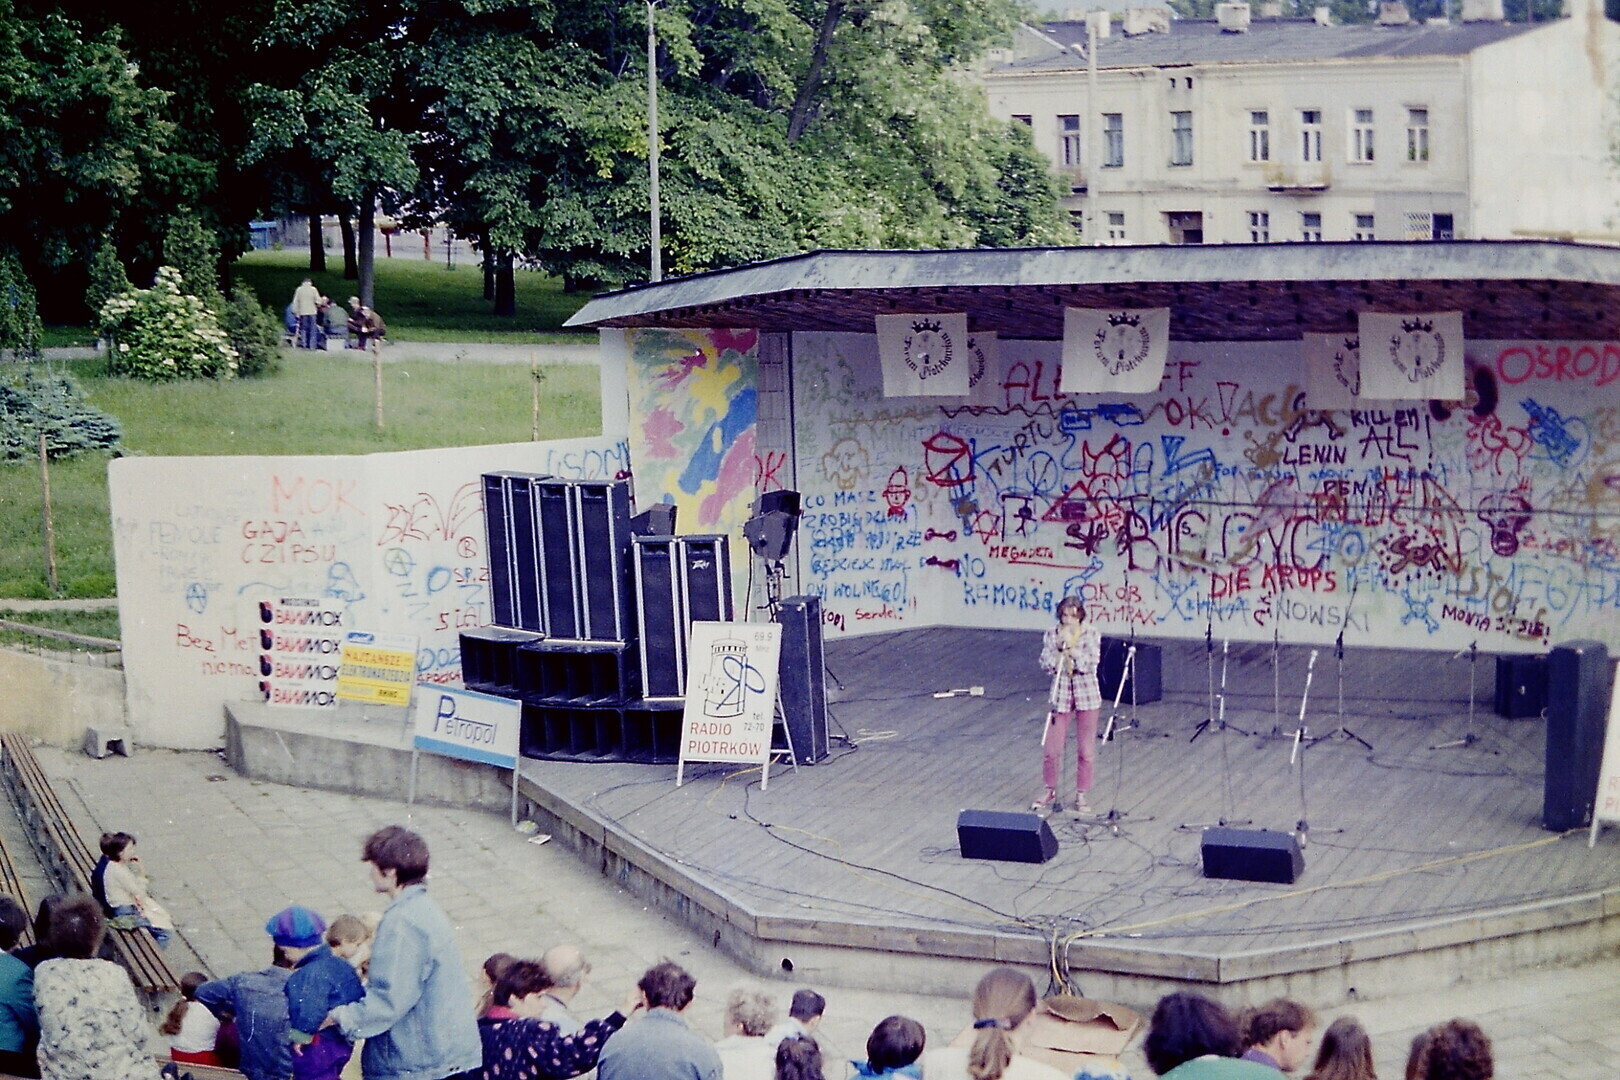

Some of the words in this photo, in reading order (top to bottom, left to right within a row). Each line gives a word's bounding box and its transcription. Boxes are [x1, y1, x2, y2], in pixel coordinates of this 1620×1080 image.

[1282, 446, 1347, 466] LENIN
[271, 474, 366, 517] MOK
[1210, 567, 1251, 600] DIE
[433, 694, 498, 745] Petropol
[689, 721, 733, 736] RADIO
